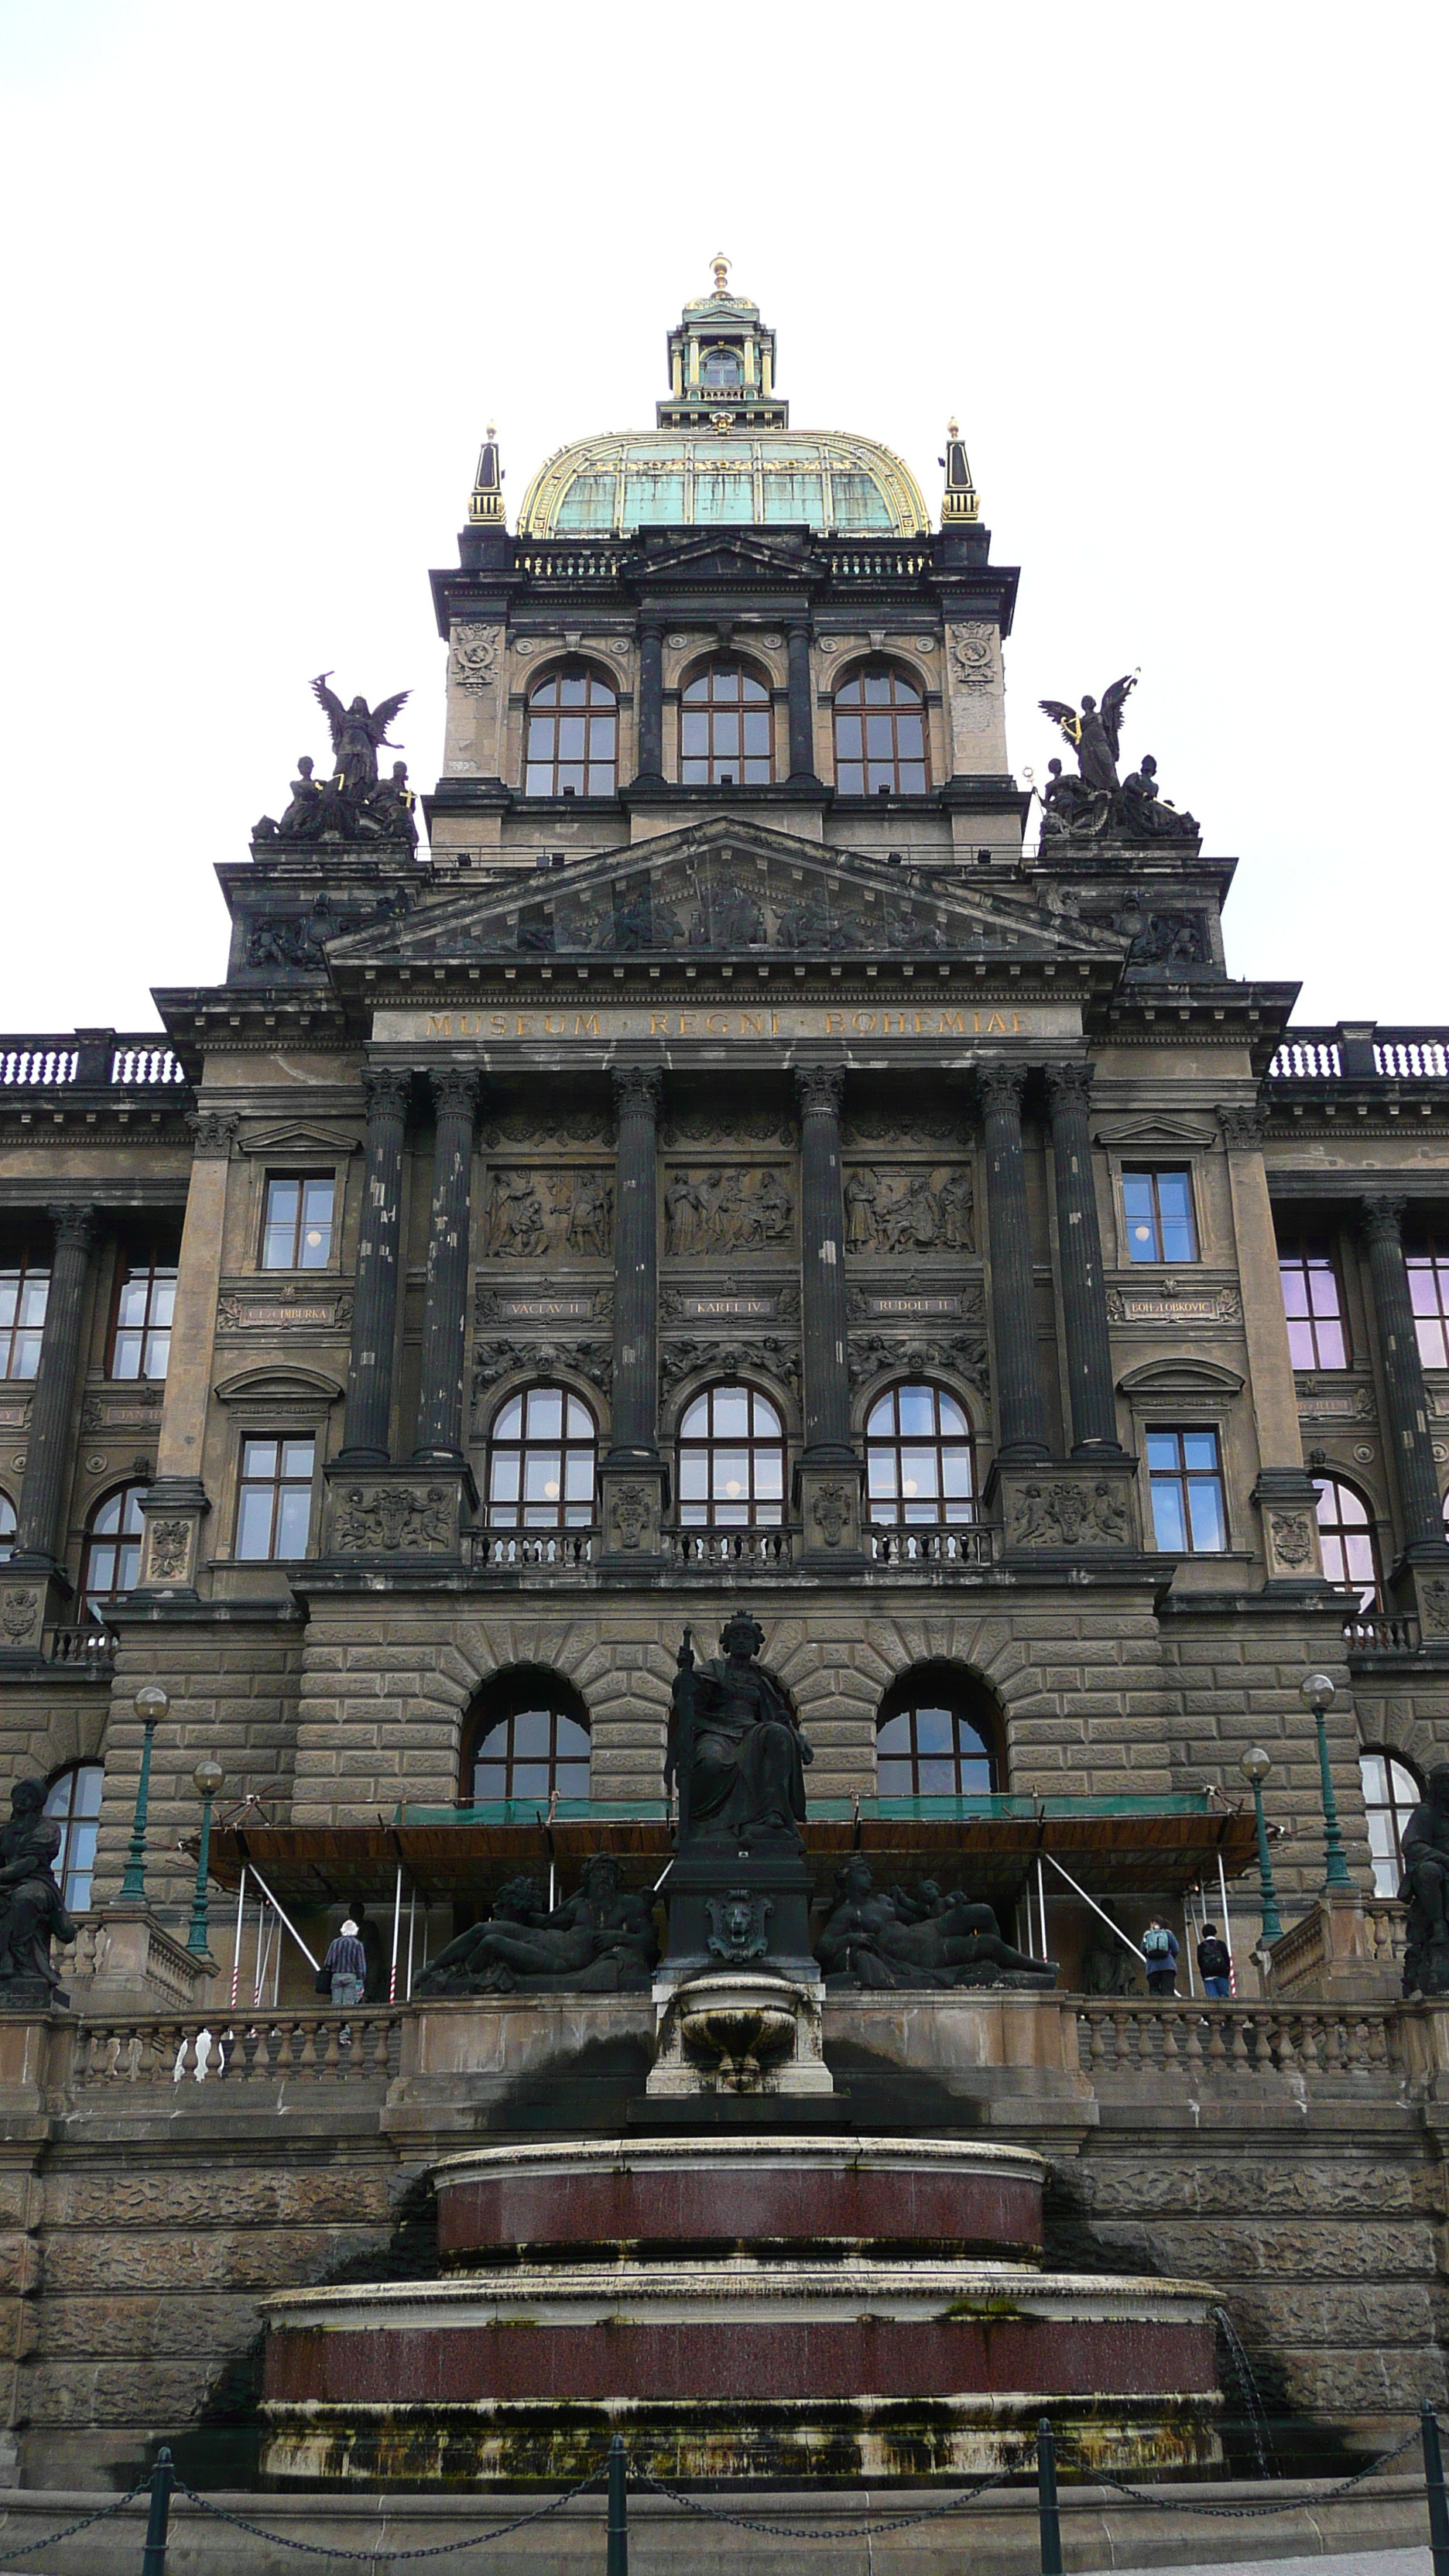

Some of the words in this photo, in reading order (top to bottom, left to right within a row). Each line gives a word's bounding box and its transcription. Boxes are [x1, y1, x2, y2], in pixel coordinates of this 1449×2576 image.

[426, 1014, 601, 1036] MUSEUM
[650, 1013, 779, 1034] REGNI
[825, 1012, 1032, 1033] BOHEMIAE
[512, 1303, 563, 1314] VACLAV
[697, 1302, 741, 1312] KAREL
[879, 1300, 932, 1310] RUDOLF
